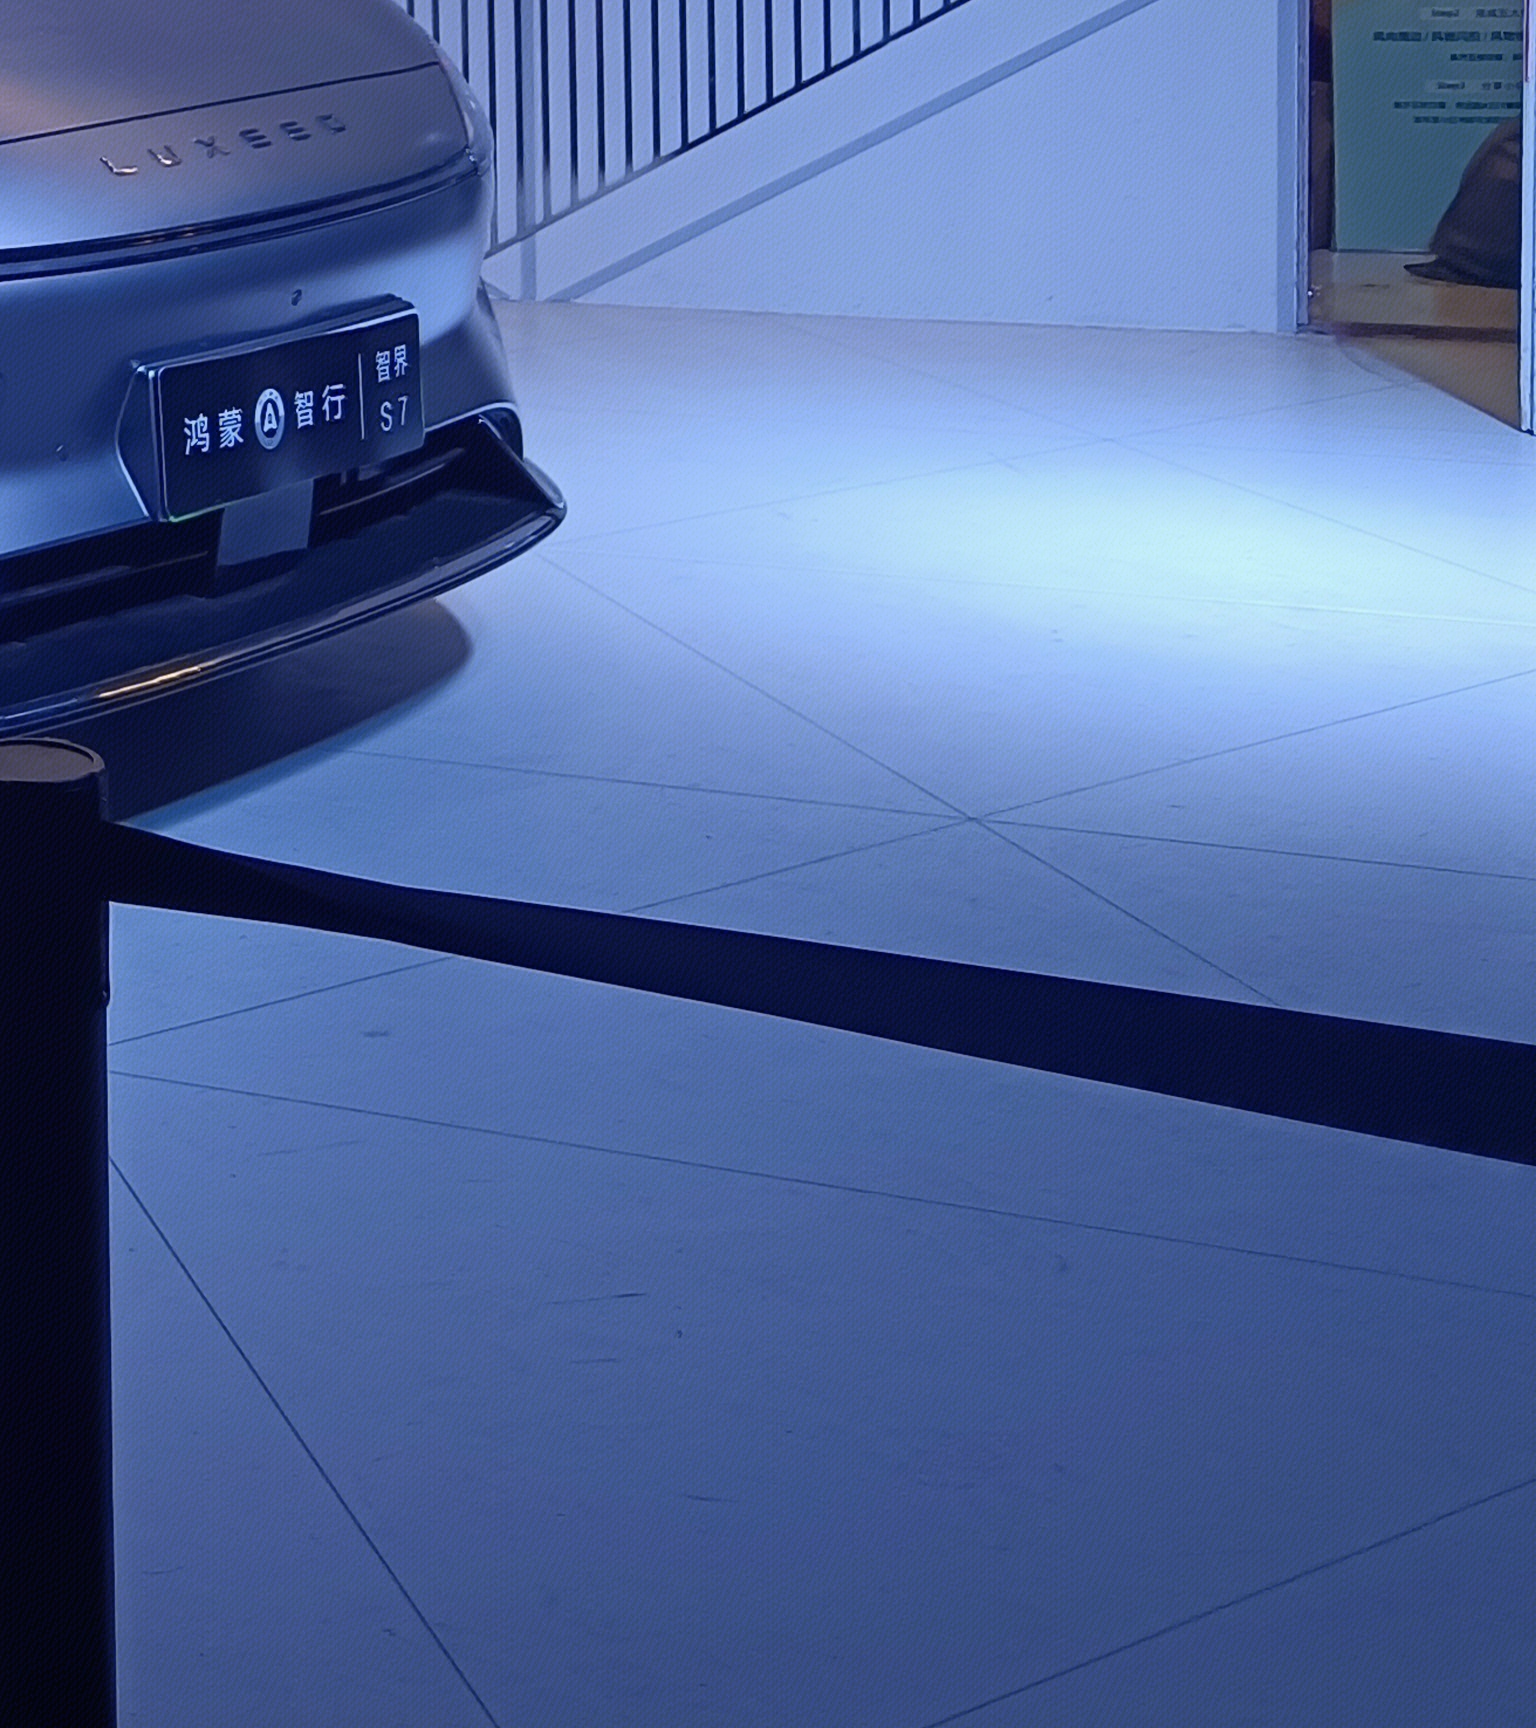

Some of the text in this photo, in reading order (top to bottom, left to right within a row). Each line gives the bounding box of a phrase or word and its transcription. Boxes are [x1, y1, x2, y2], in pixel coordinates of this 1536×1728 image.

[99, 113, 348, 177] LUXEED
[374, 344, 409, 384] 智界
[183, 383, 346, 455] 鸿蒙 智行
[379, 395, 409, 433] S7
